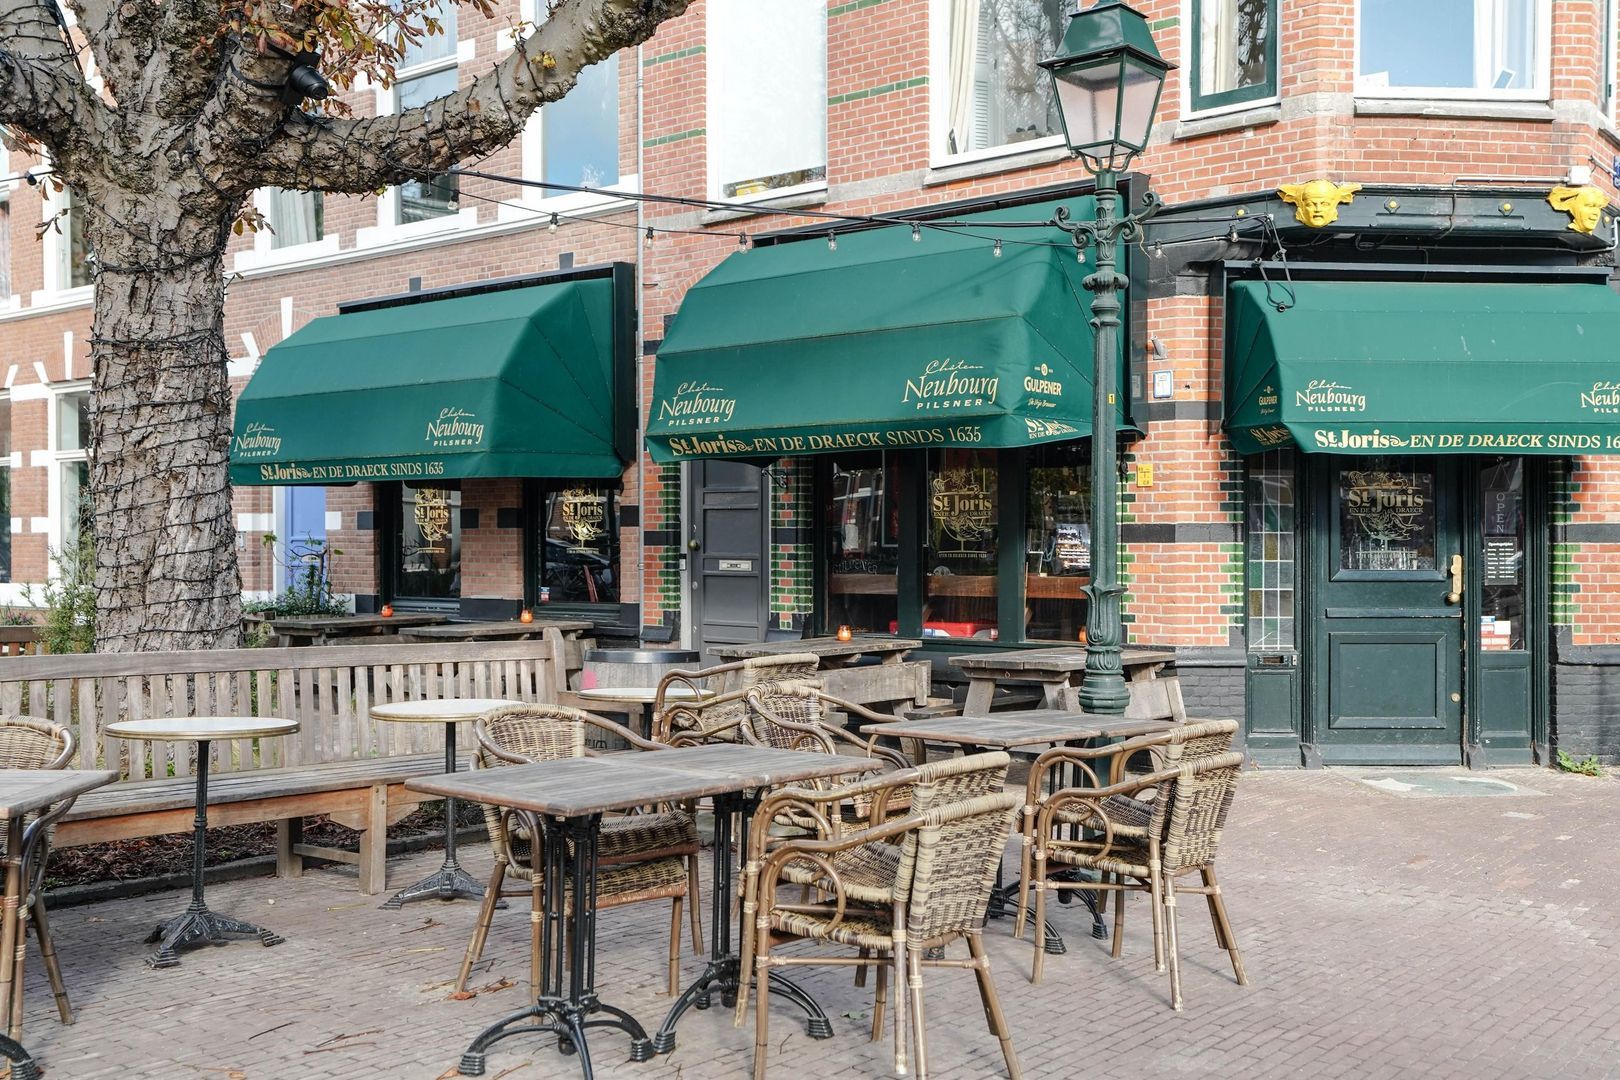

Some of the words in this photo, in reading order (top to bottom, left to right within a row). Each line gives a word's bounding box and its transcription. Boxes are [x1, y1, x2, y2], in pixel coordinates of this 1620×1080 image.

[902, 371, 999, 404] Neubourg
[1024, 376, 1062, 395] GULPENER
[658, 392, 736, 421] Neubourg
[917, 399, 982, 409] PILSNER
[1295, 389, 1366, 411] Neubourg
[425, 417, 484, 444] Neubourg
[668, 417, 720, 426] PILSNER
[234, 431, 281, 455] Neubourg
[753, 438, 778, 451] EN
[780, 436, 804, 450] DE
[807, 432, 882, 449] DRAECK
[887, 428, 944, 445] SINDS
[948, 427, 981, 442] 1635
[1410, 435, 1435, 448] EN
[1438, 434, 1464, 447] DE
[1467, 434, 1543, 448] DRAECK
[1547, 435, 1600, 448] SINDS
[312, 467, 327, 478] EN
[329, 465, 343, 477] DE
[346, 463, 388, 477] DRAECK
[390, 463, 421, 475] SINDS
[425, 462, 444, 475] 1635
[1496, 493, 1505, 533] OPEN
